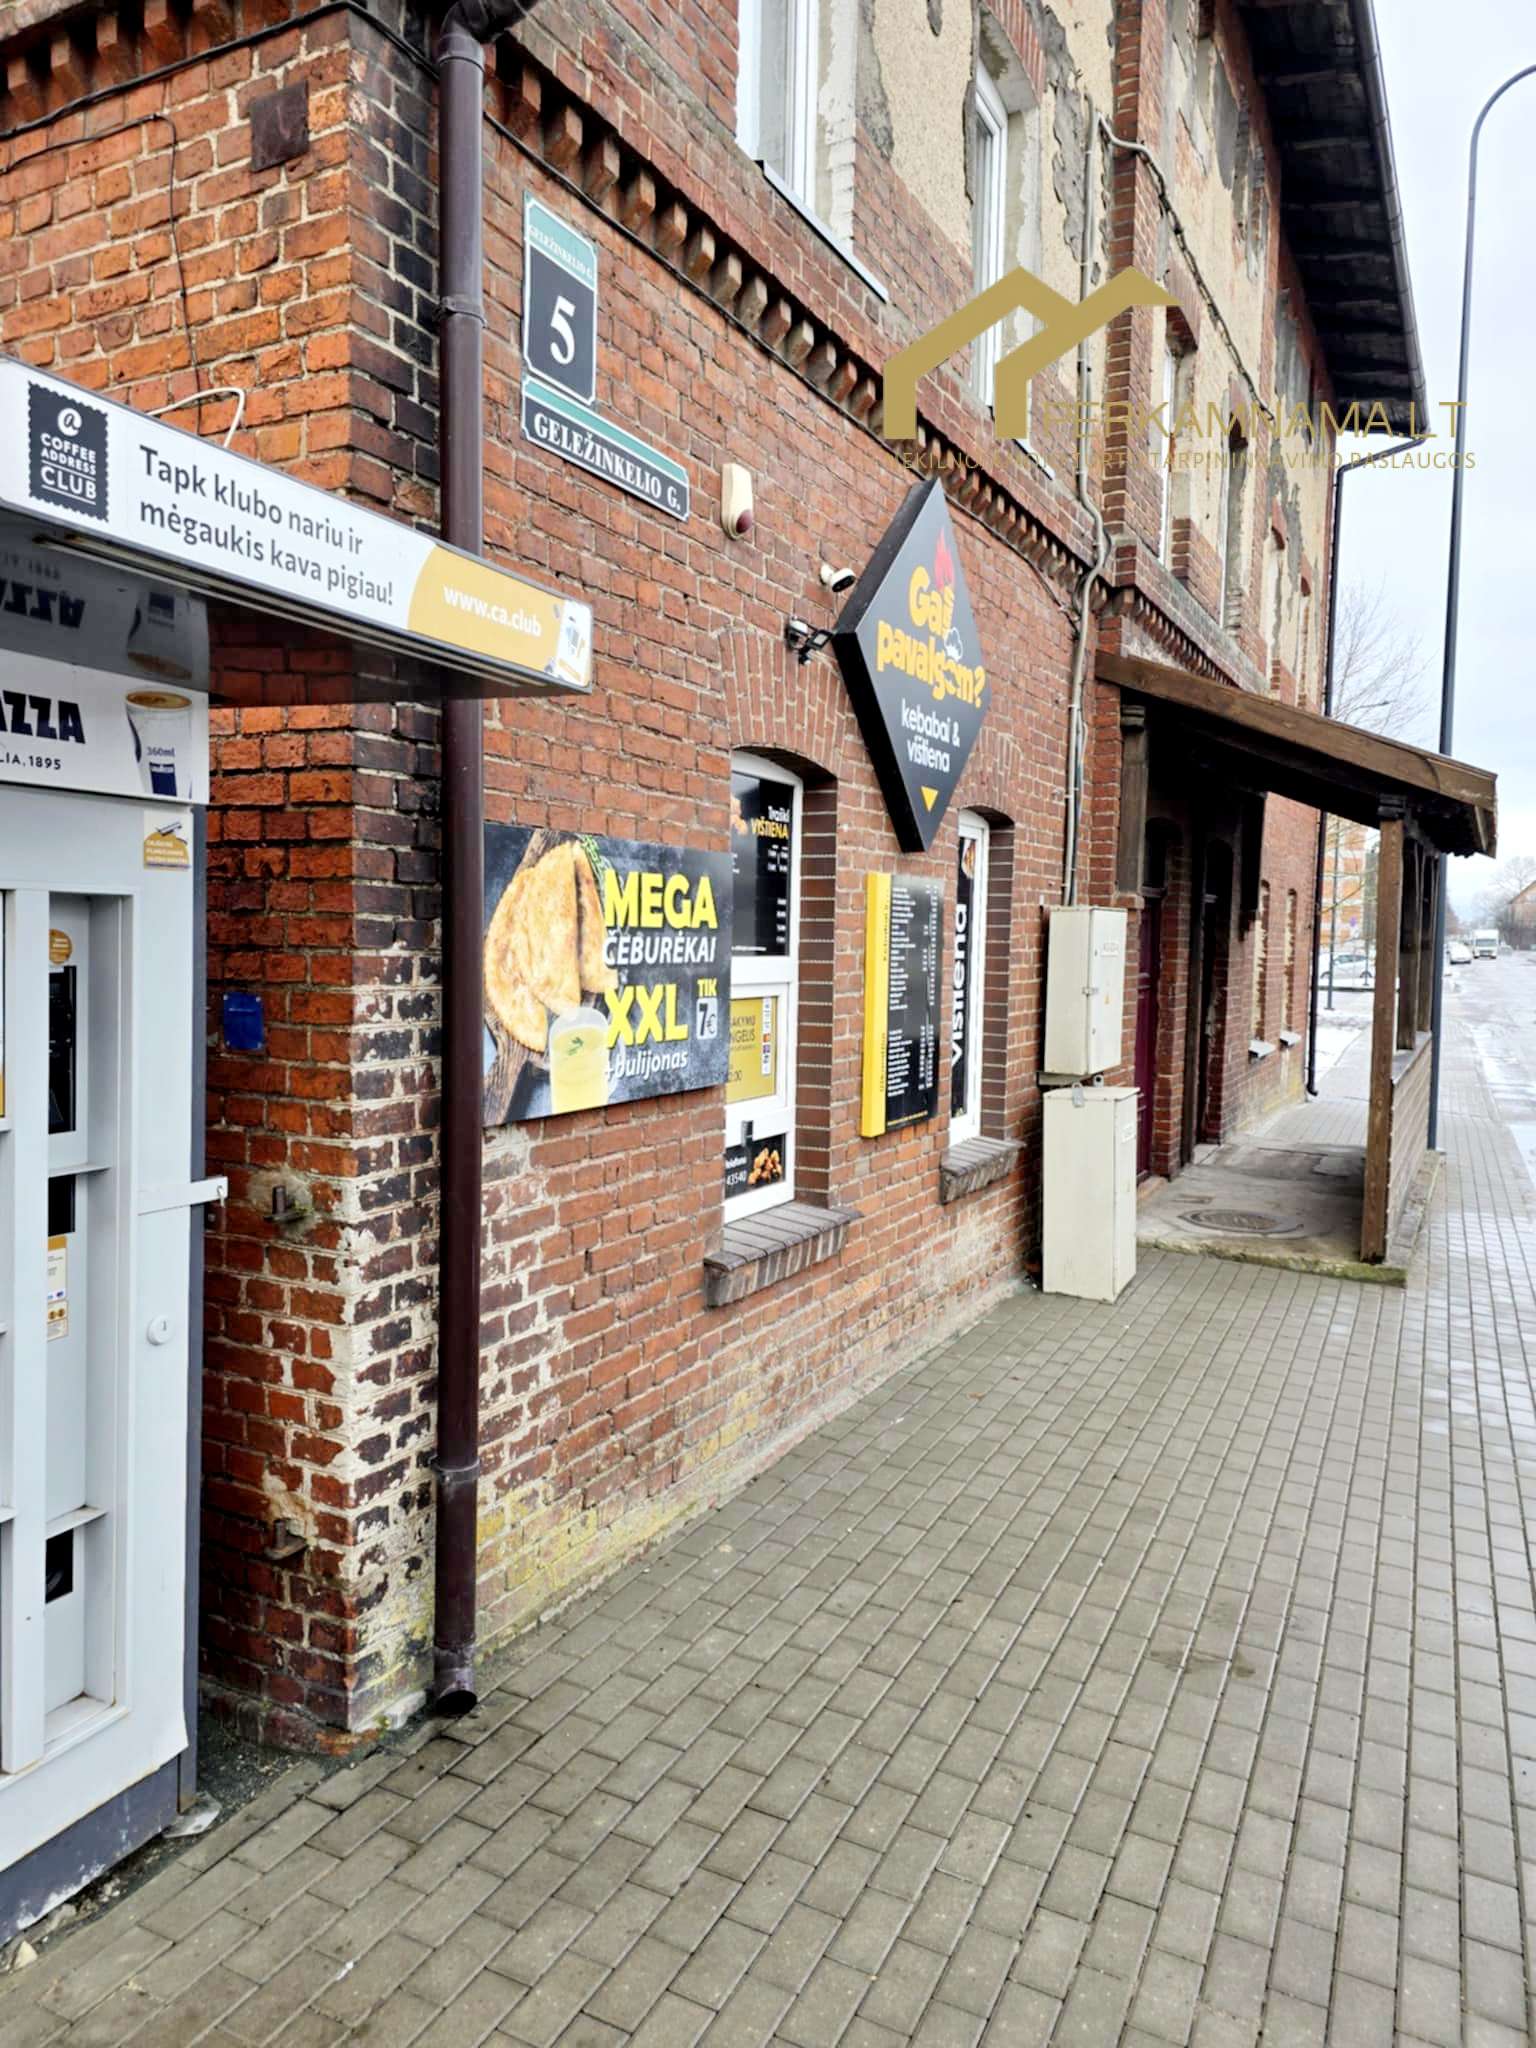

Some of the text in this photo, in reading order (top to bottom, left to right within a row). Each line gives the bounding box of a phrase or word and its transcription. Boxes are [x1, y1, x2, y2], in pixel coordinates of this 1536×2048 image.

[549, 295, 576, 364] 5
[40, 432, 97, 464] COFFEE
[40, 448, 97, 476] ADDRESS
[533, 411, 681, 511] GELEŽINKELIO G.
[40, 466, 97, 500] CLUB
[139, 444, 363, 556] Tapk klubo nariu ir
[139, 498, 394, 607] mėgaukis kava pigiau!
[443, 582, 542, 638] www.ca.club
[901, 698, 961, 747] kebabai &
[29, 755, 62, 770] 1895
[603, 869, 718, 930] MEGA
[602, 930, 717, 966] ČEBURĖKAI
[697, 977, 718, 998] TIK
[604, 982, 689, 1049] XXL
